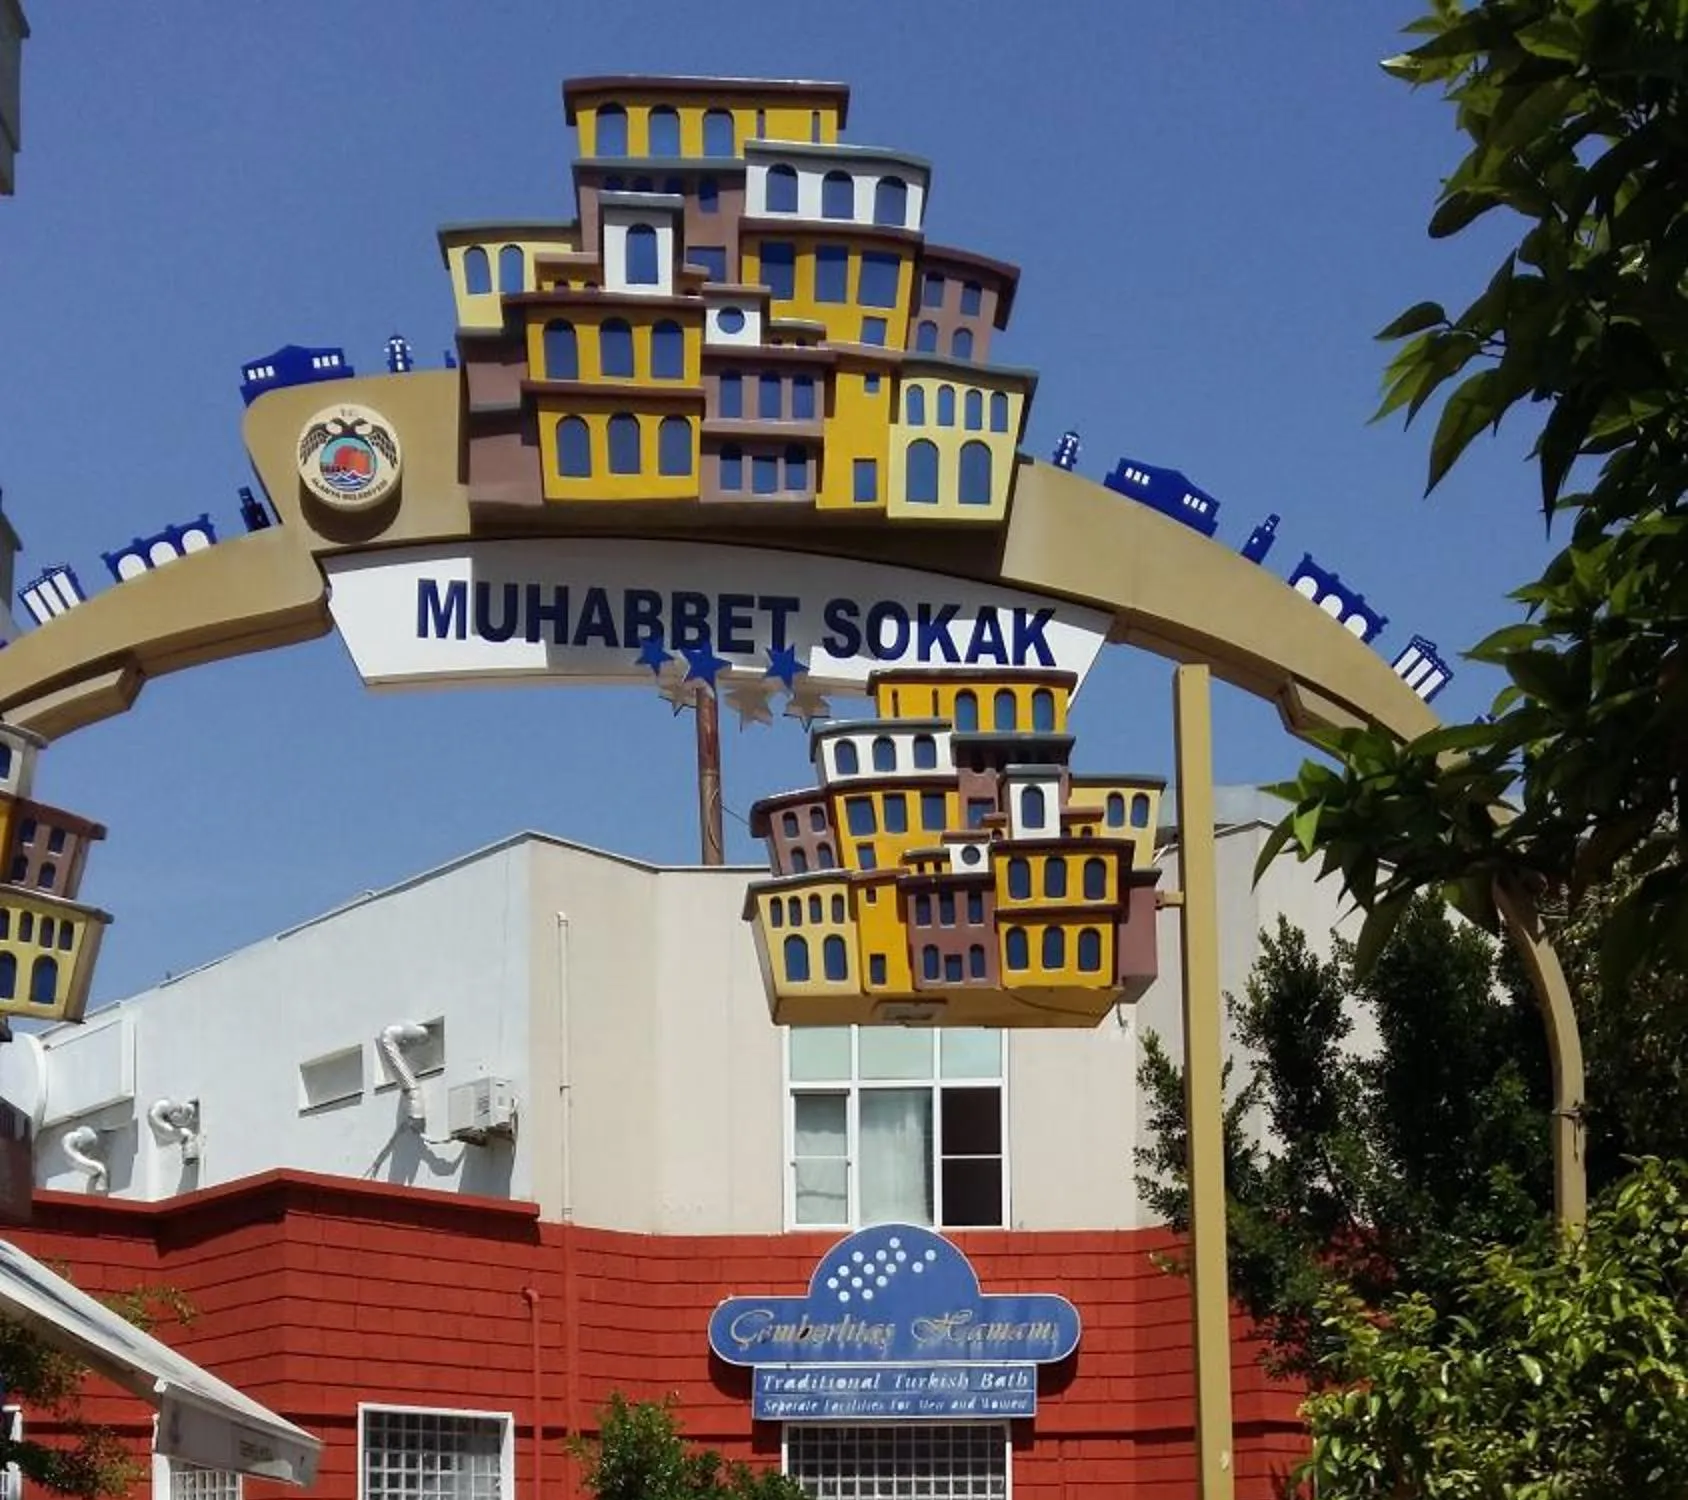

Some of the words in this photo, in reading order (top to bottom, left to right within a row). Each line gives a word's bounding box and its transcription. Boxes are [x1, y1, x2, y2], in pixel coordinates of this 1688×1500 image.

[416, 578, 801, 654] MUHABBET
[821, 597, 1057, 667] SOKAK
[763, 1371, 880, 1391] Traditional
[895, 1371, 969, 1391] Turkish
[980, 1371, 1028, 1390] Bath
[951, 1396, 977, 1410] and
